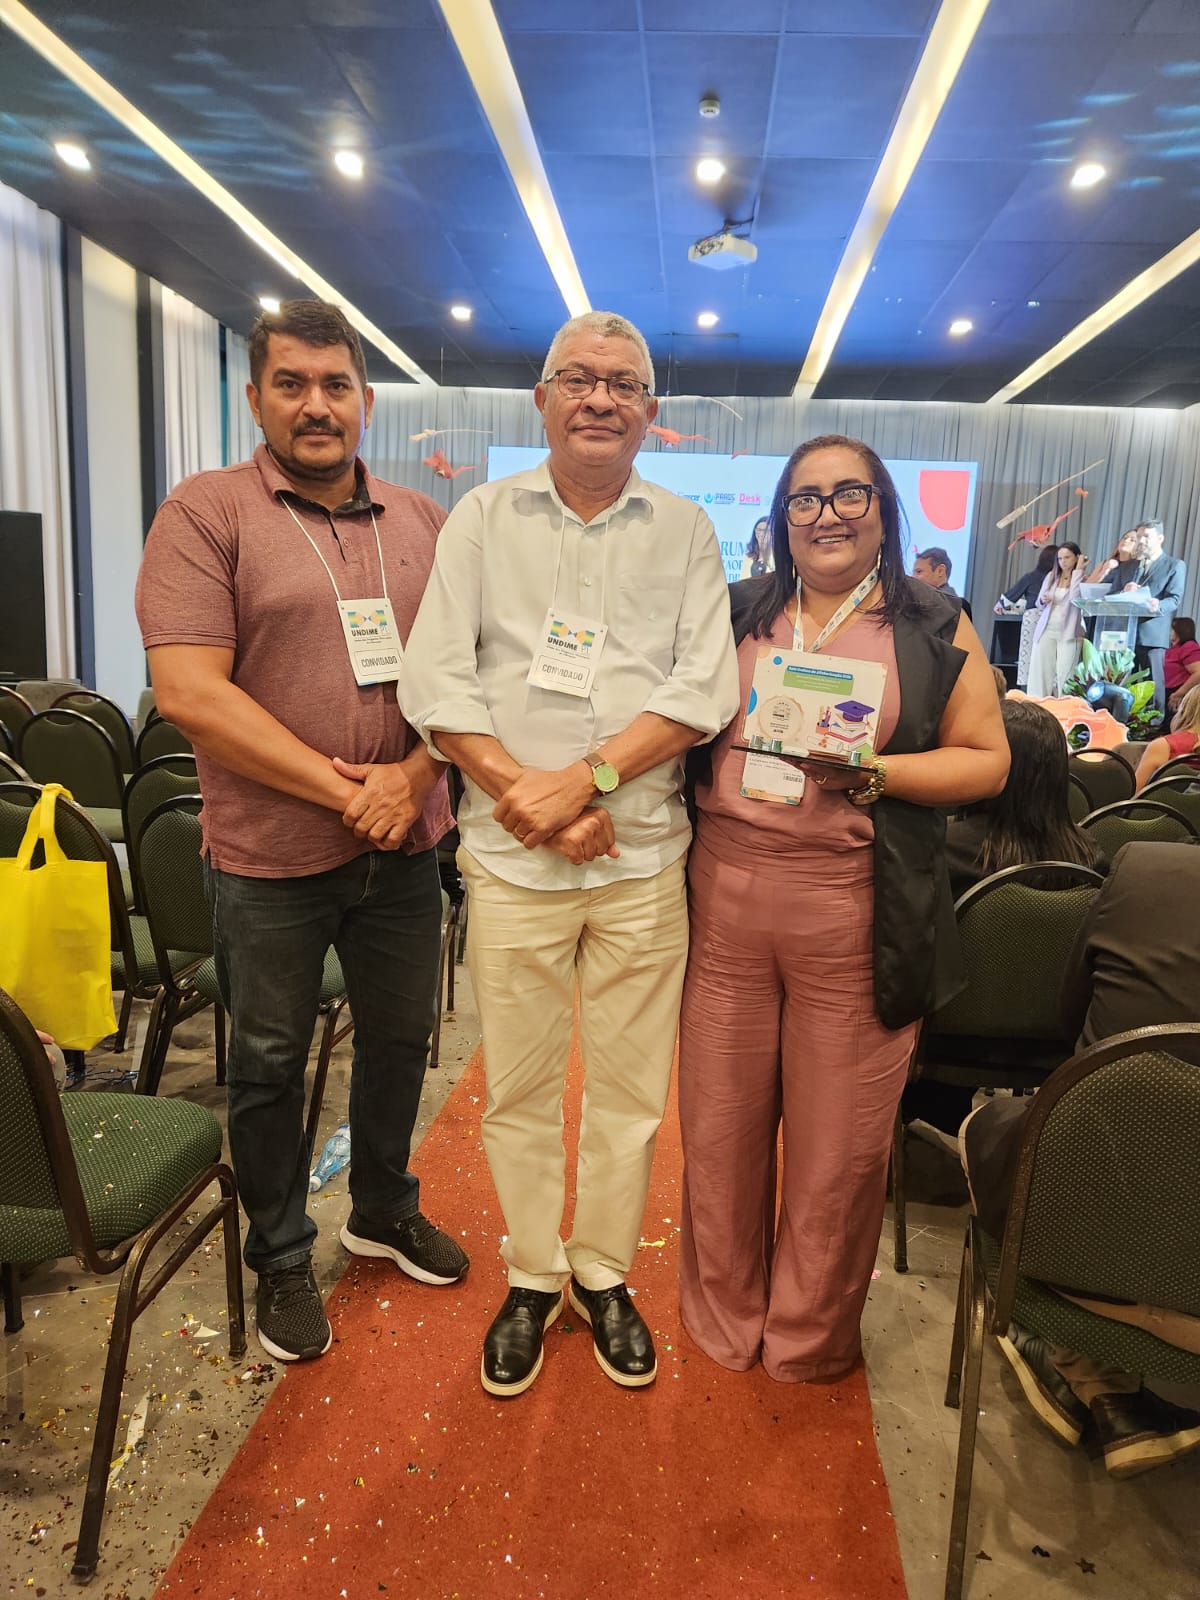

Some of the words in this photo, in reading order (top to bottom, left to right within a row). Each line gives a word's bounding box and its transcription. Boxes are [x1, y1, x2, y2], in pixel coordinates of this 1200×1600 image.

[351, 628, 379, 637] UNDIME
[547, 637, 578, 651] UNDIME
[361, 656, 398, 668] CONVIDADO
[542, 664, 584, 681] CONVIDADO
